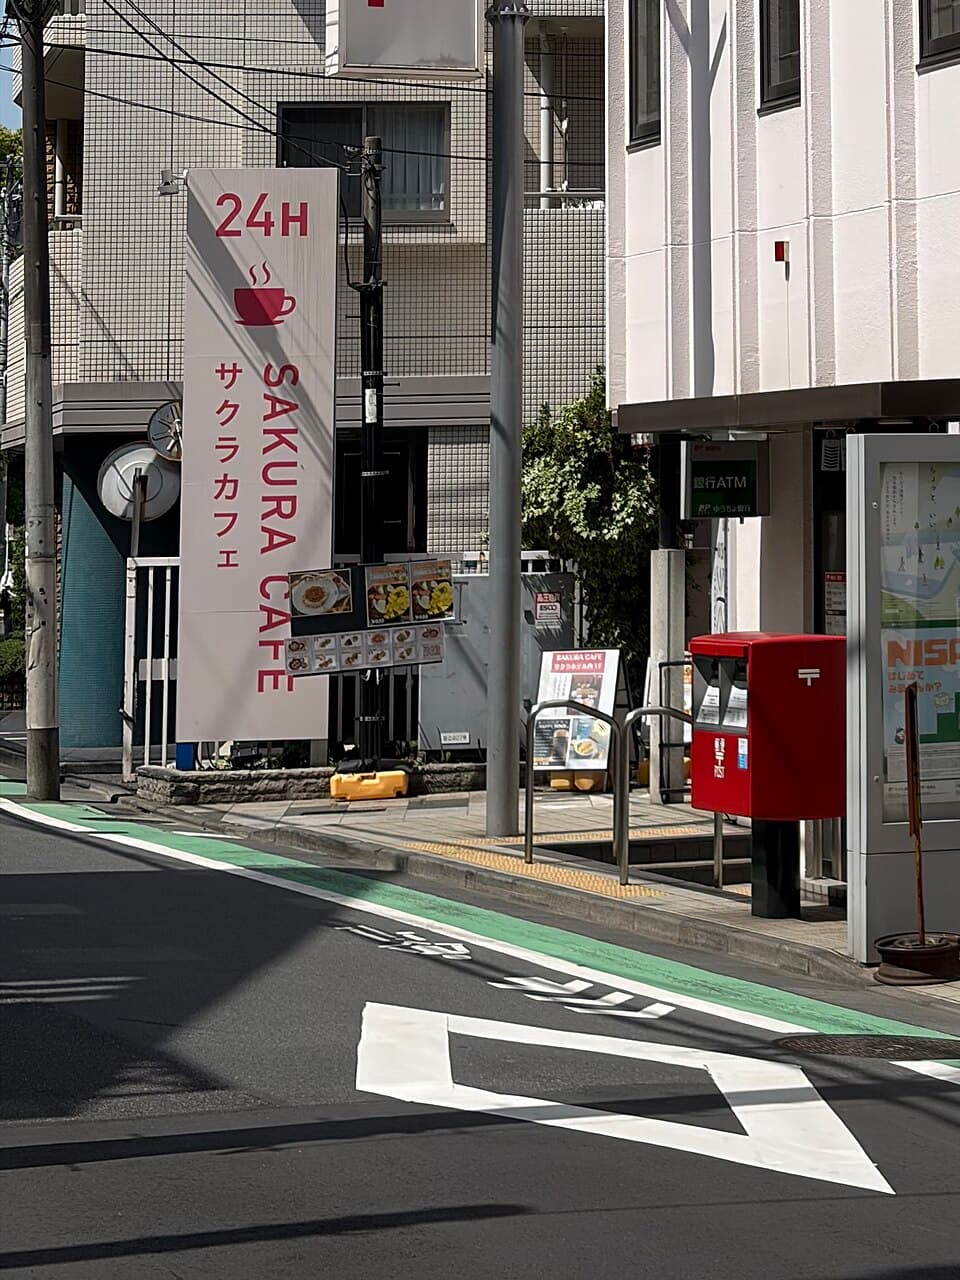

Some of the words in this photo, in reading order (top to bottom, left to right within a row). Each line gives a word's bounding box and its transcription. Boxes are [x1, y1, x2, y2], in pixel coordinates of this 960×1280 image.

[215, 192, 308, 237] 24H
[213, 362, 243, 568] サクラカフェ
[260, 363, 299, 555] SAKURA
[257, 575, 294, 693] CAFE
